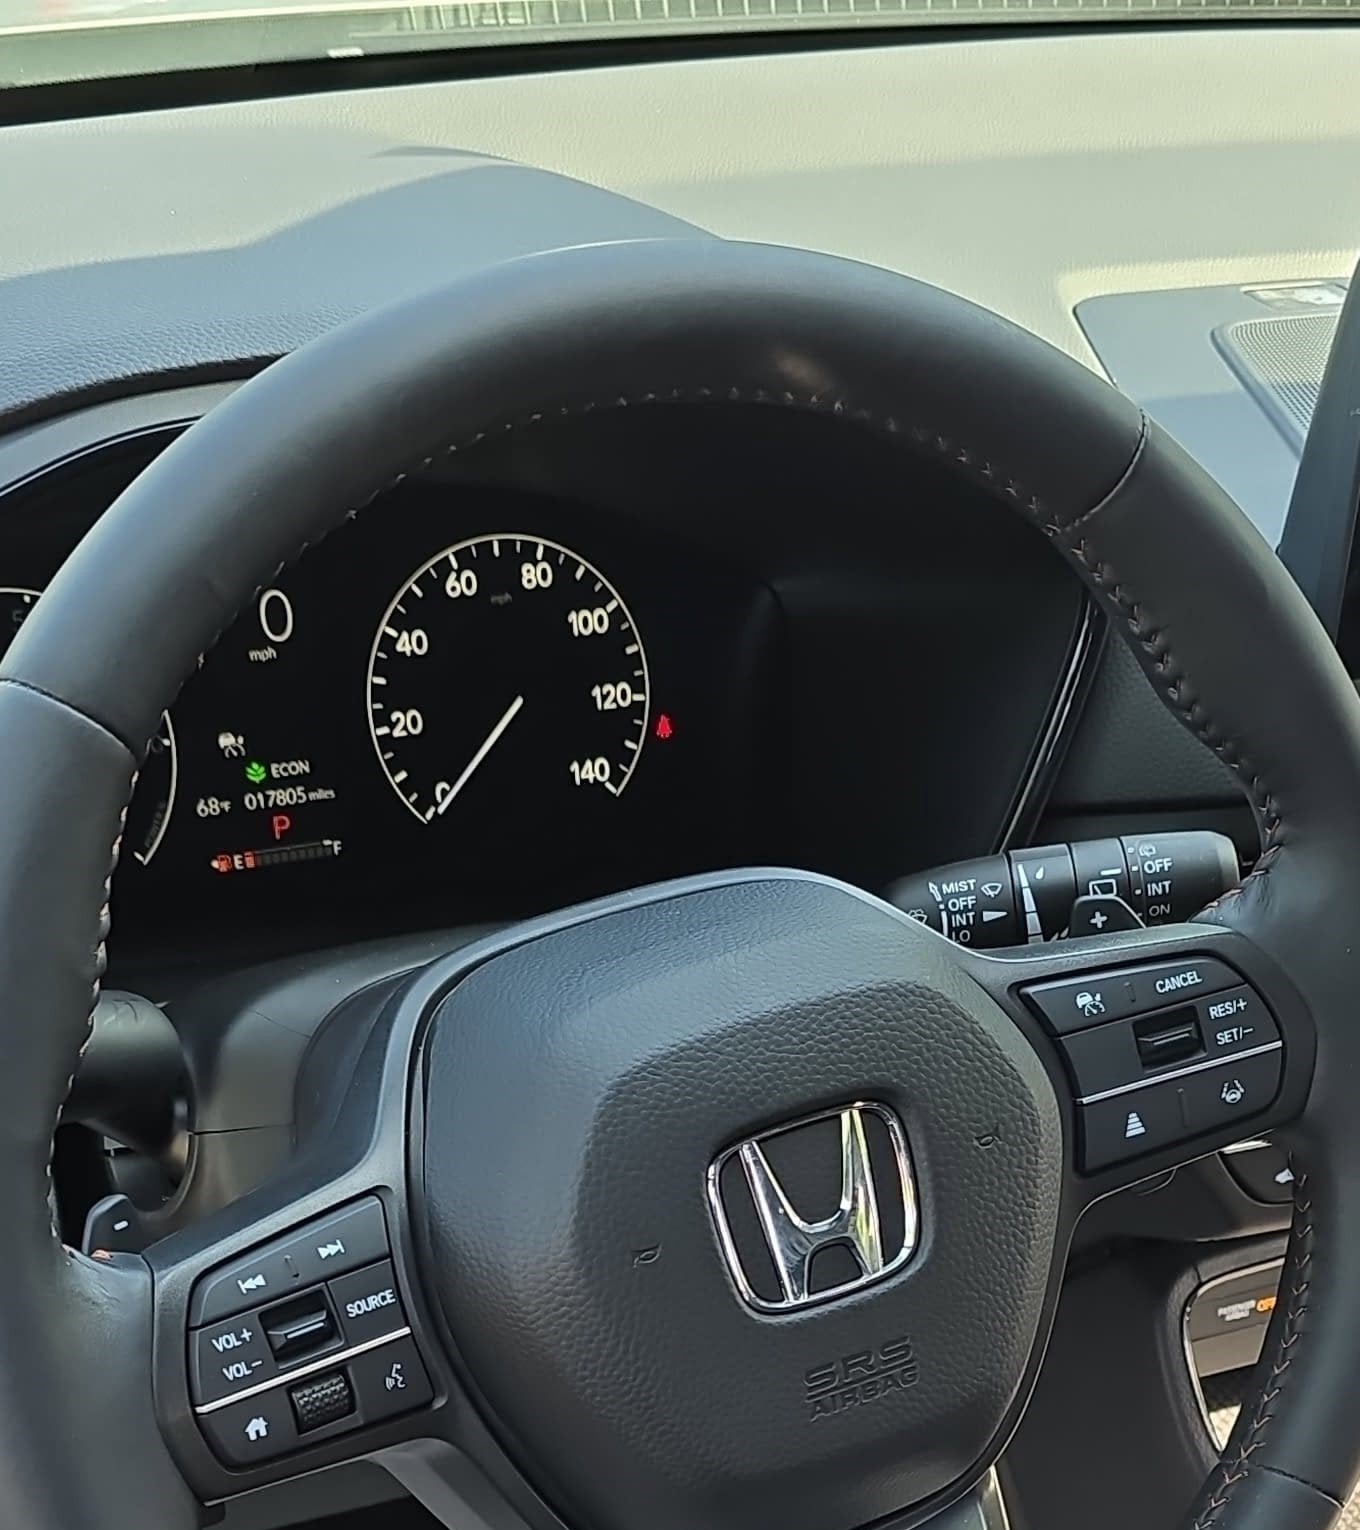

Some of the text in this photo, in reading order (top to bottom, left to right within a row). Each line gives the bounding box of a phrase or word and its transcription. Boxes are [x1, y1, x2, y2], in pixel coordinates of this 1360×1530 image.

[445, 568, 478, 598] 60
[521, 560, 553, 590] 80
[259, 588, 293, 643] 0
[567, 607, 609, 637] 100
[248, 646, 278, 663] mph
[395, 629, 428, 657] 40
[591, 681, 632, 711] 120
[390, 709, 423, 738] 20
[270, 760, 310, 779] ECON
[569, 757, 610, 786] 140
[244, 786, 307, 811] 017805
[273, 815, 290, 839] P
[1143, 858, 1174, 874] OFF
[942, 878, 977, 894] MIST
[1146, 880, 1172, 897] INT
[947, 896, 977, 911] OFF
[1148, 904, 1171, 918] ON
[952, 912, 975, 927] INT
[1154, 969, 1203, 994] CANCEL
[1208, 998, 1248, 1020] RES/+
[345, 1288, 396, 1318] SOURCE
[211, 1327, 253, 1353] VOL+
[803, 1335, 913, 1397] SRS
[809, 1361, 920, 1423] AIRBAG
